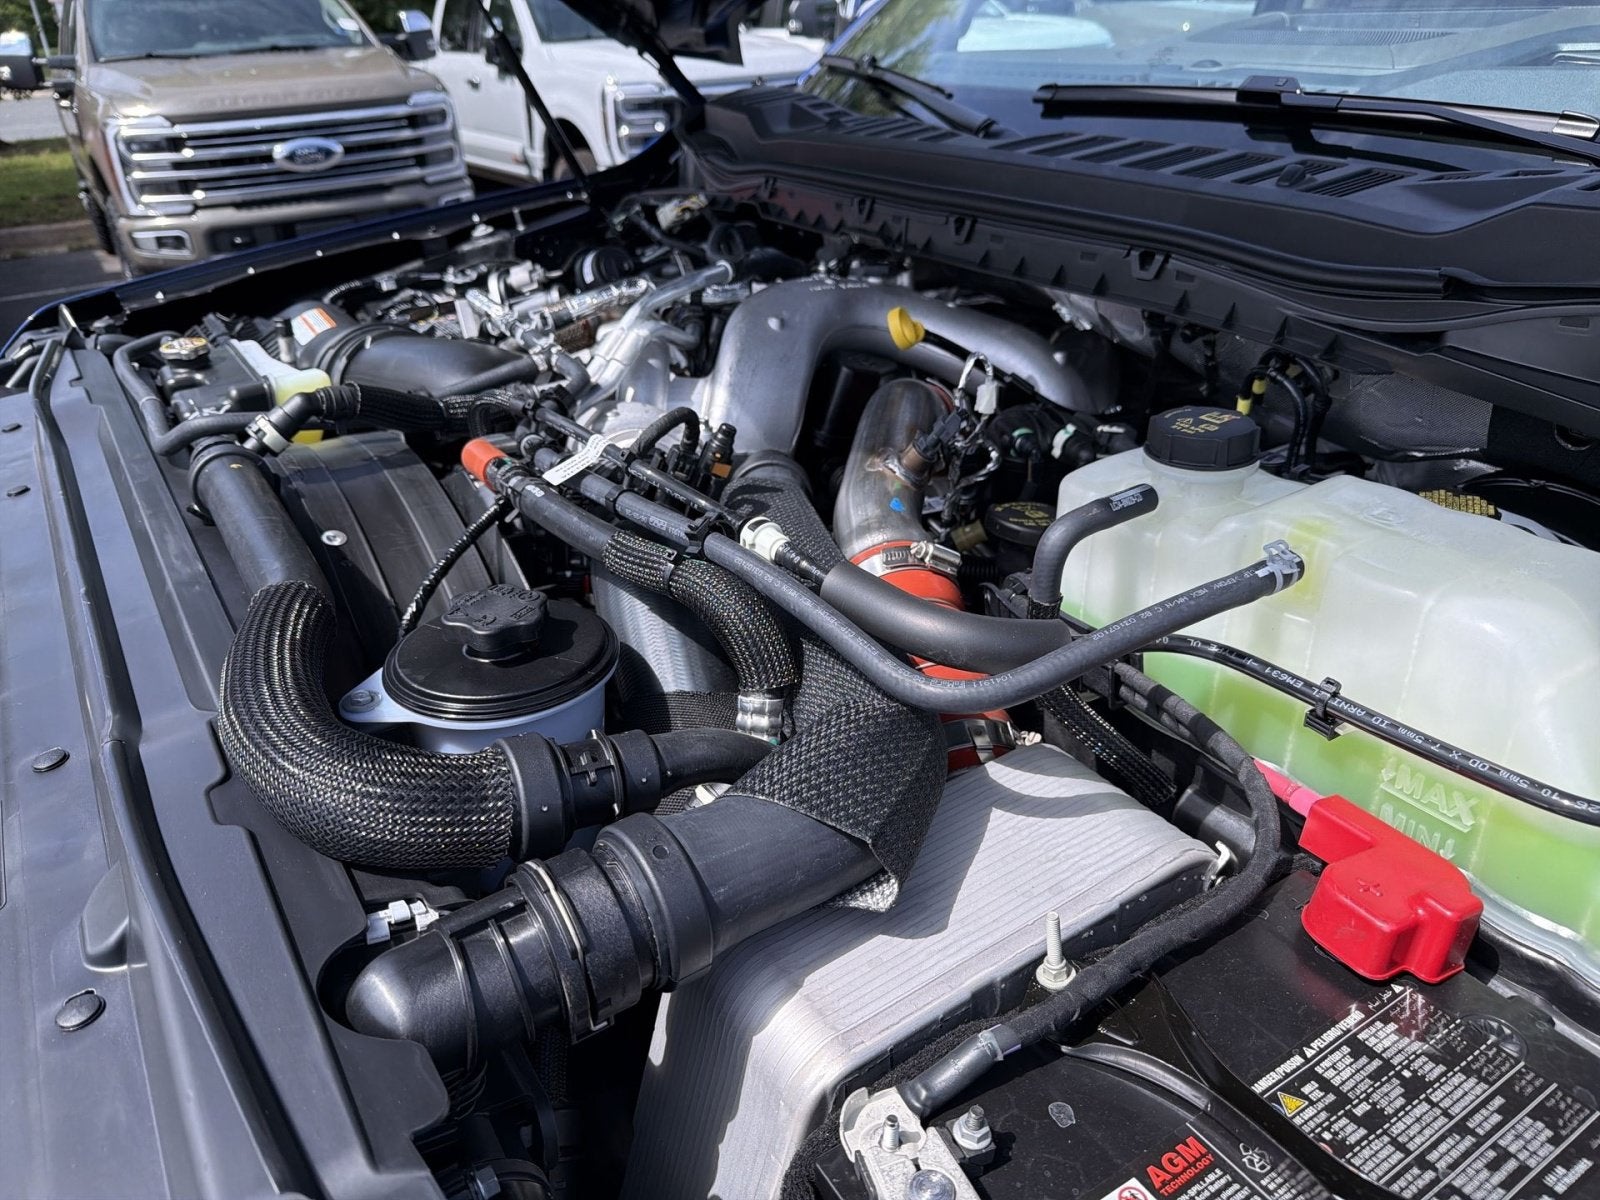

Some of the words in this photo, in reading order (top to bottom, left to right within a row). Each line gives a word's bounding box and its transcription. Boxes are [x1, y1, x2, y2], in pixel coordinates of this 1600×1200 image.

[1186, 638, 1202, 648] UL
[1371, 716, 1392, 729] ID
[1398, 727, 1441, 752] 7.5mm
[1468, 758, 1490, 771] OD
[1394, 764, 1479, 827] MAX
[1146, 1135, 1208, 1189] AGM
[1160, 1153, 1215, 1197] TECHNOLOGY
